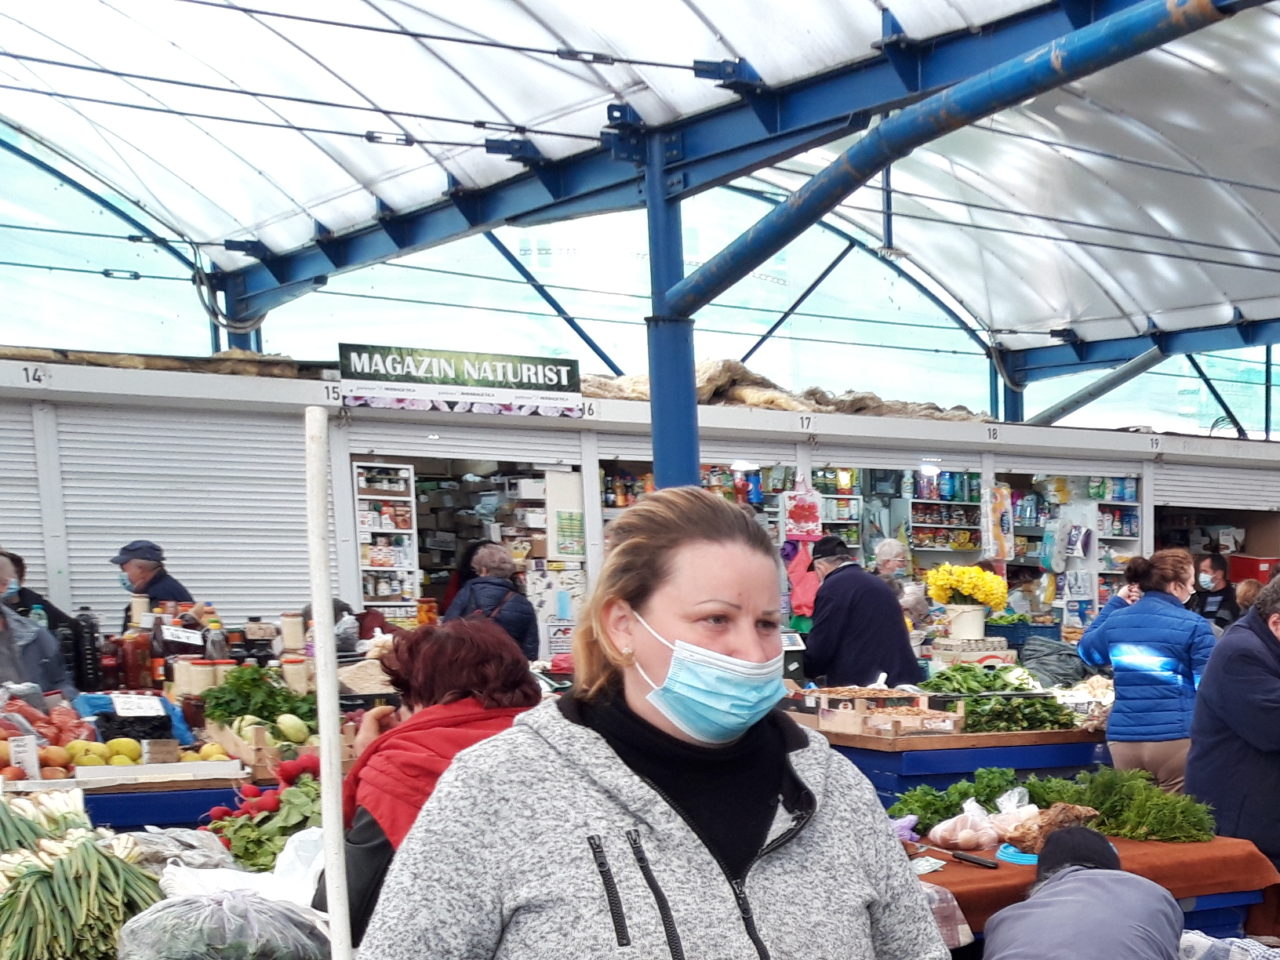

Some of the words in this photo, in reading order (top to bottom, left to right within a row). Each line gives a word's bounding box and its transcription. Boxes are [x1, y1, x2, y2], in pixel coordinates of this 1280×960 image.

[22, 367, 42, 383] 14
[350, 352, 456, 378] MAGAZIN
[464, 357, 571, 386] NATURIST
[324, 386, 340, 401] 15
[581, 403, 595, 417] 16
[800, 416, 811, 429] 17
[987, 428, 998, 440] 18
[1150, 438, 1160, 450] 19
